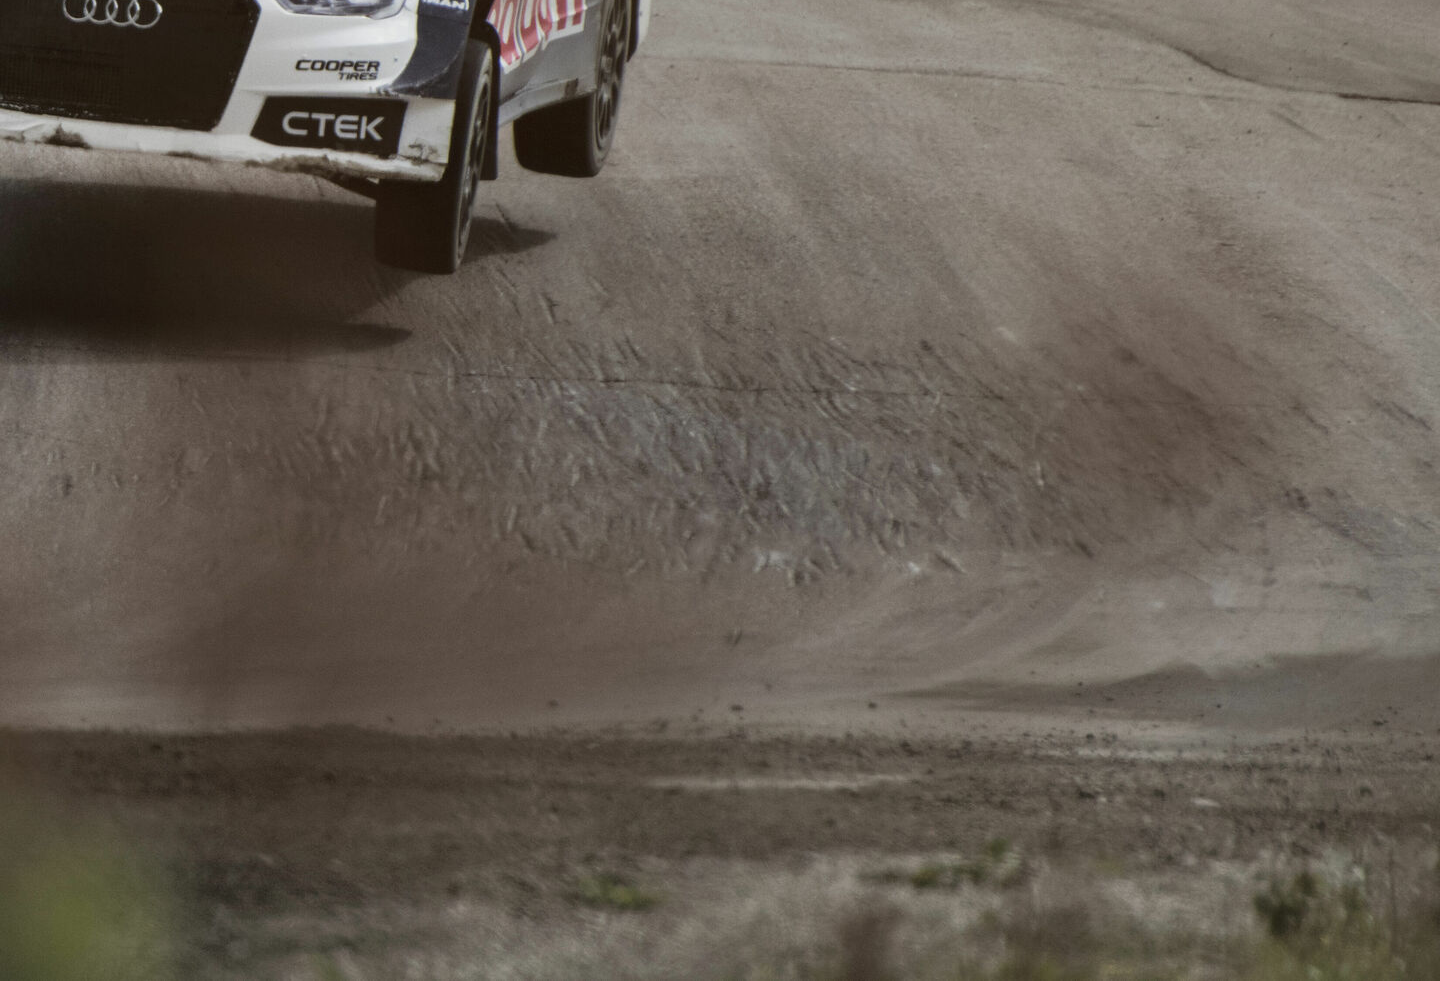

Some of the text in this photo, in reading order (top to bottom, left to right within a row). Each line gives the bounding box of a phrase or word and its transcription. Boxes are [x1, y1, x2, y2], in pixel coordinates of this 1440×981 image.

[295, 59, 381, 72] COOPER
[338, 72, 379, 81] TIRES
[281, 110, 385, 142] CTEK
